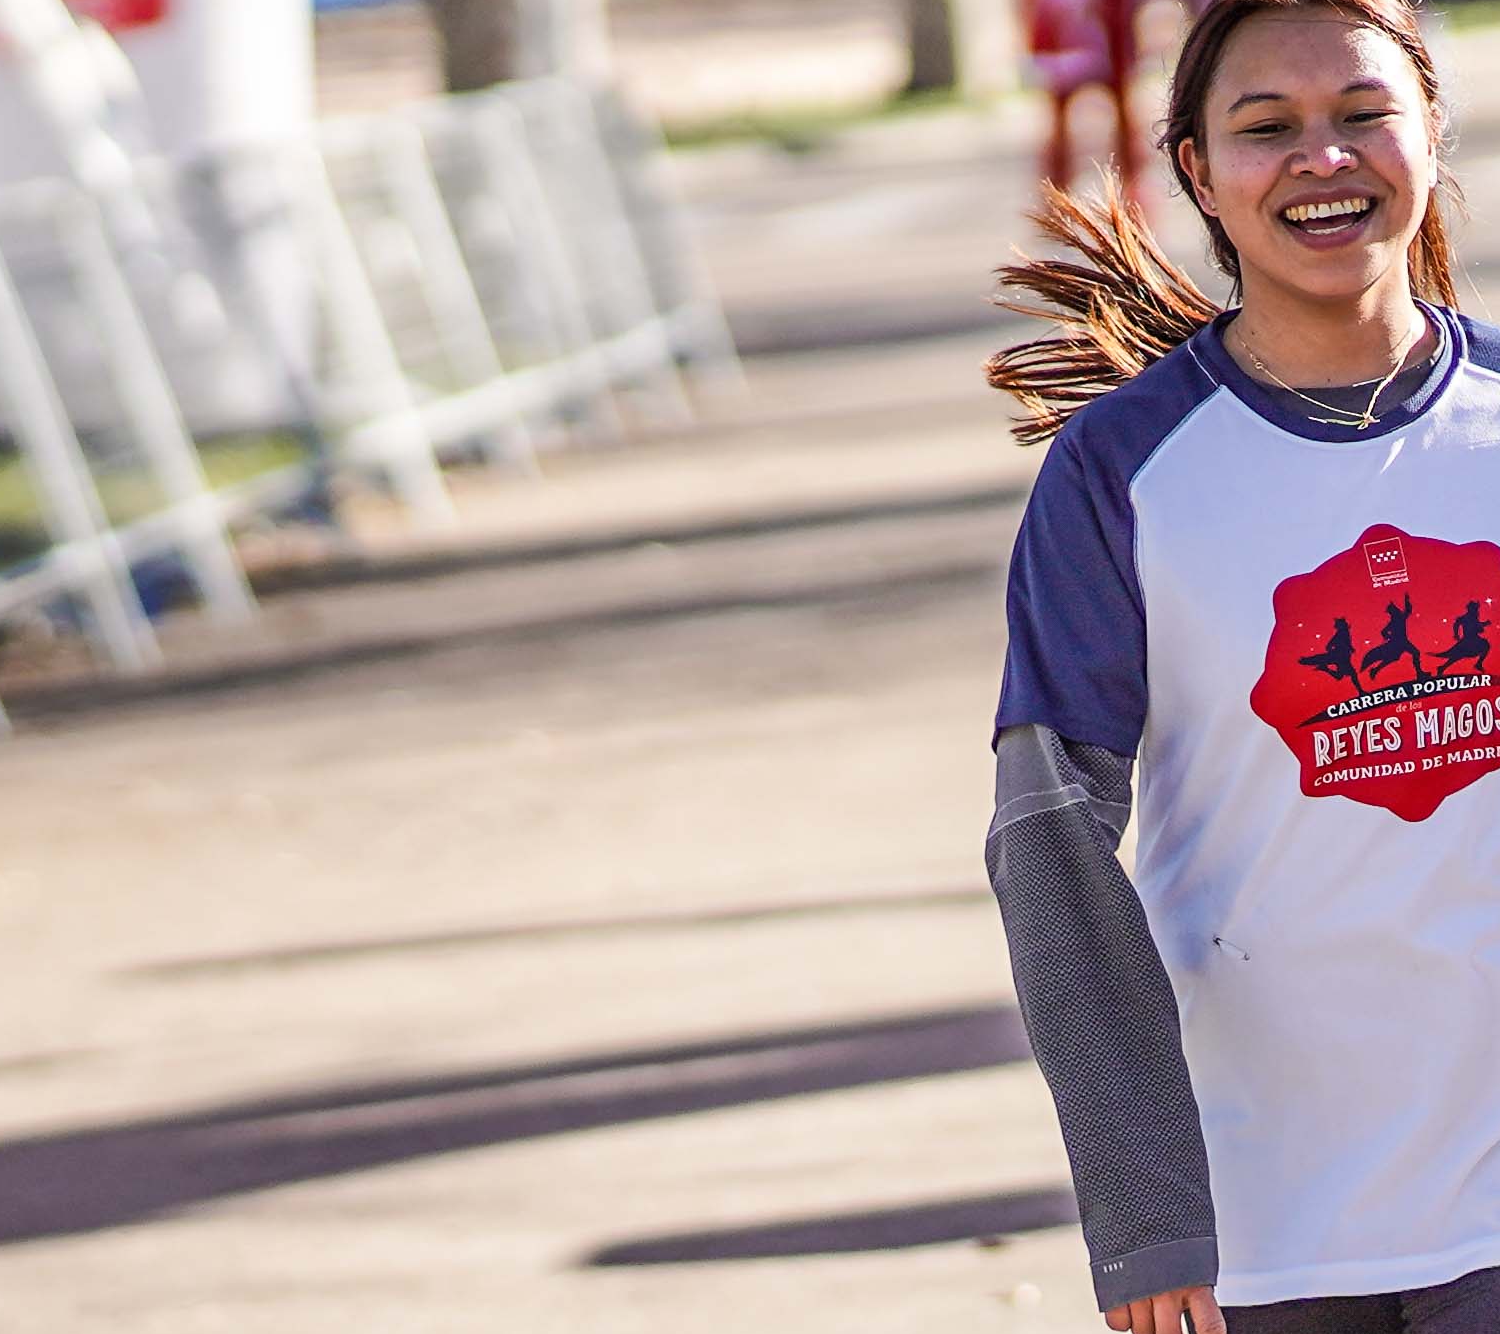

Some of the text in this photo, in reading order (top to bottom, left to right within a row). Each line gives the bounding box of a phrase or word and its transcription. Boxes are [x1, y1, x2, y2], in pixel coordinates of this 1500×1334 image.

[1327, 675, 1491, 717] CARRERA POPULAR
[1396, 701, 1422, 713] de los
[1313, 716, 1401, 767] REYES
[1314, 761, 1415, 786] COMUNIDAD
[1422, 756, 1443, 770] DE
